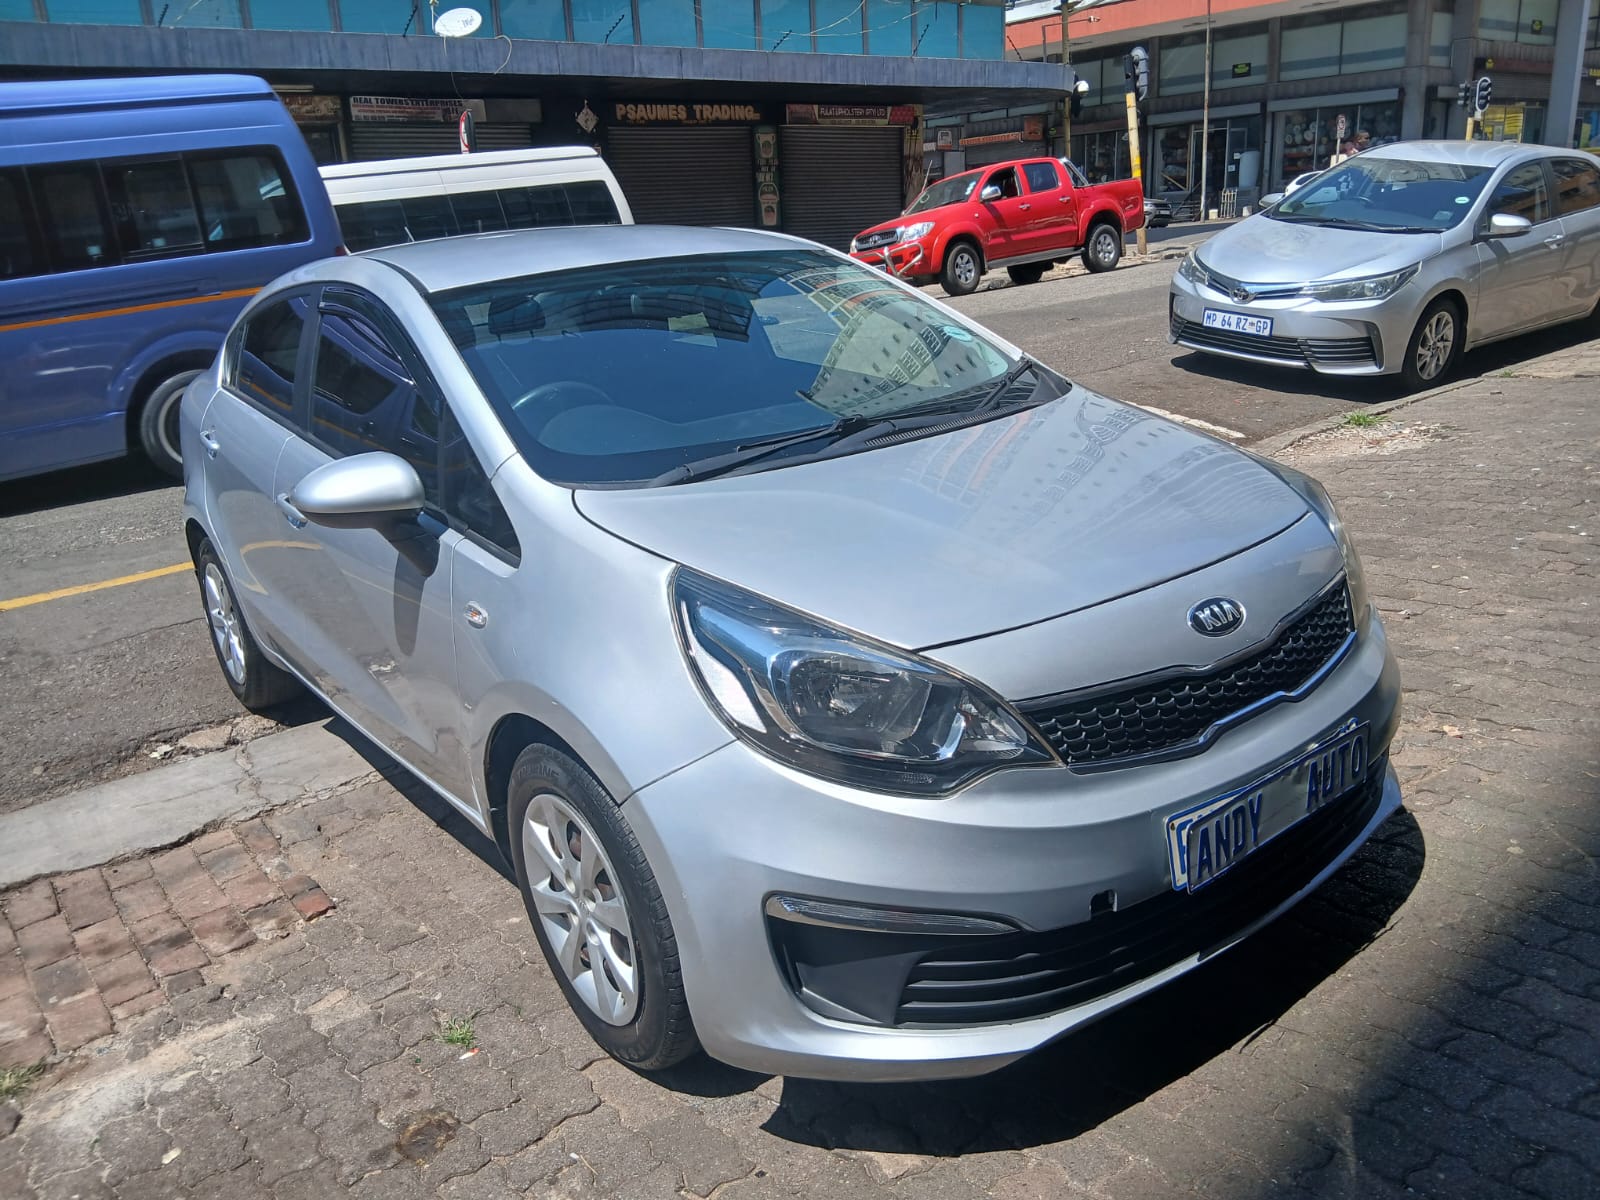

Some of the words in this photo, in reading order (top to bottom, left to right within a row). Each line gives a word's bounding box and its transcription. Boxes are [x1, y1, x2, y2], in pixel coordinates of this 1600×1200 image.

[374, 98, 409, 106] TOWERS
[615, 103, 688, 120] PSAUMES
[1205, 312, 1217, 326] MP
[1221, 315, 1232, 329] 64
[1235, 317, 1248, 331] RZ
[1255, 319, 1269, 334] GP
[1195, 601, 1240, 630] KIA
[1197, 791, 1263, 880] ANDY
[1307, 735, 1364, 810] AUTO
